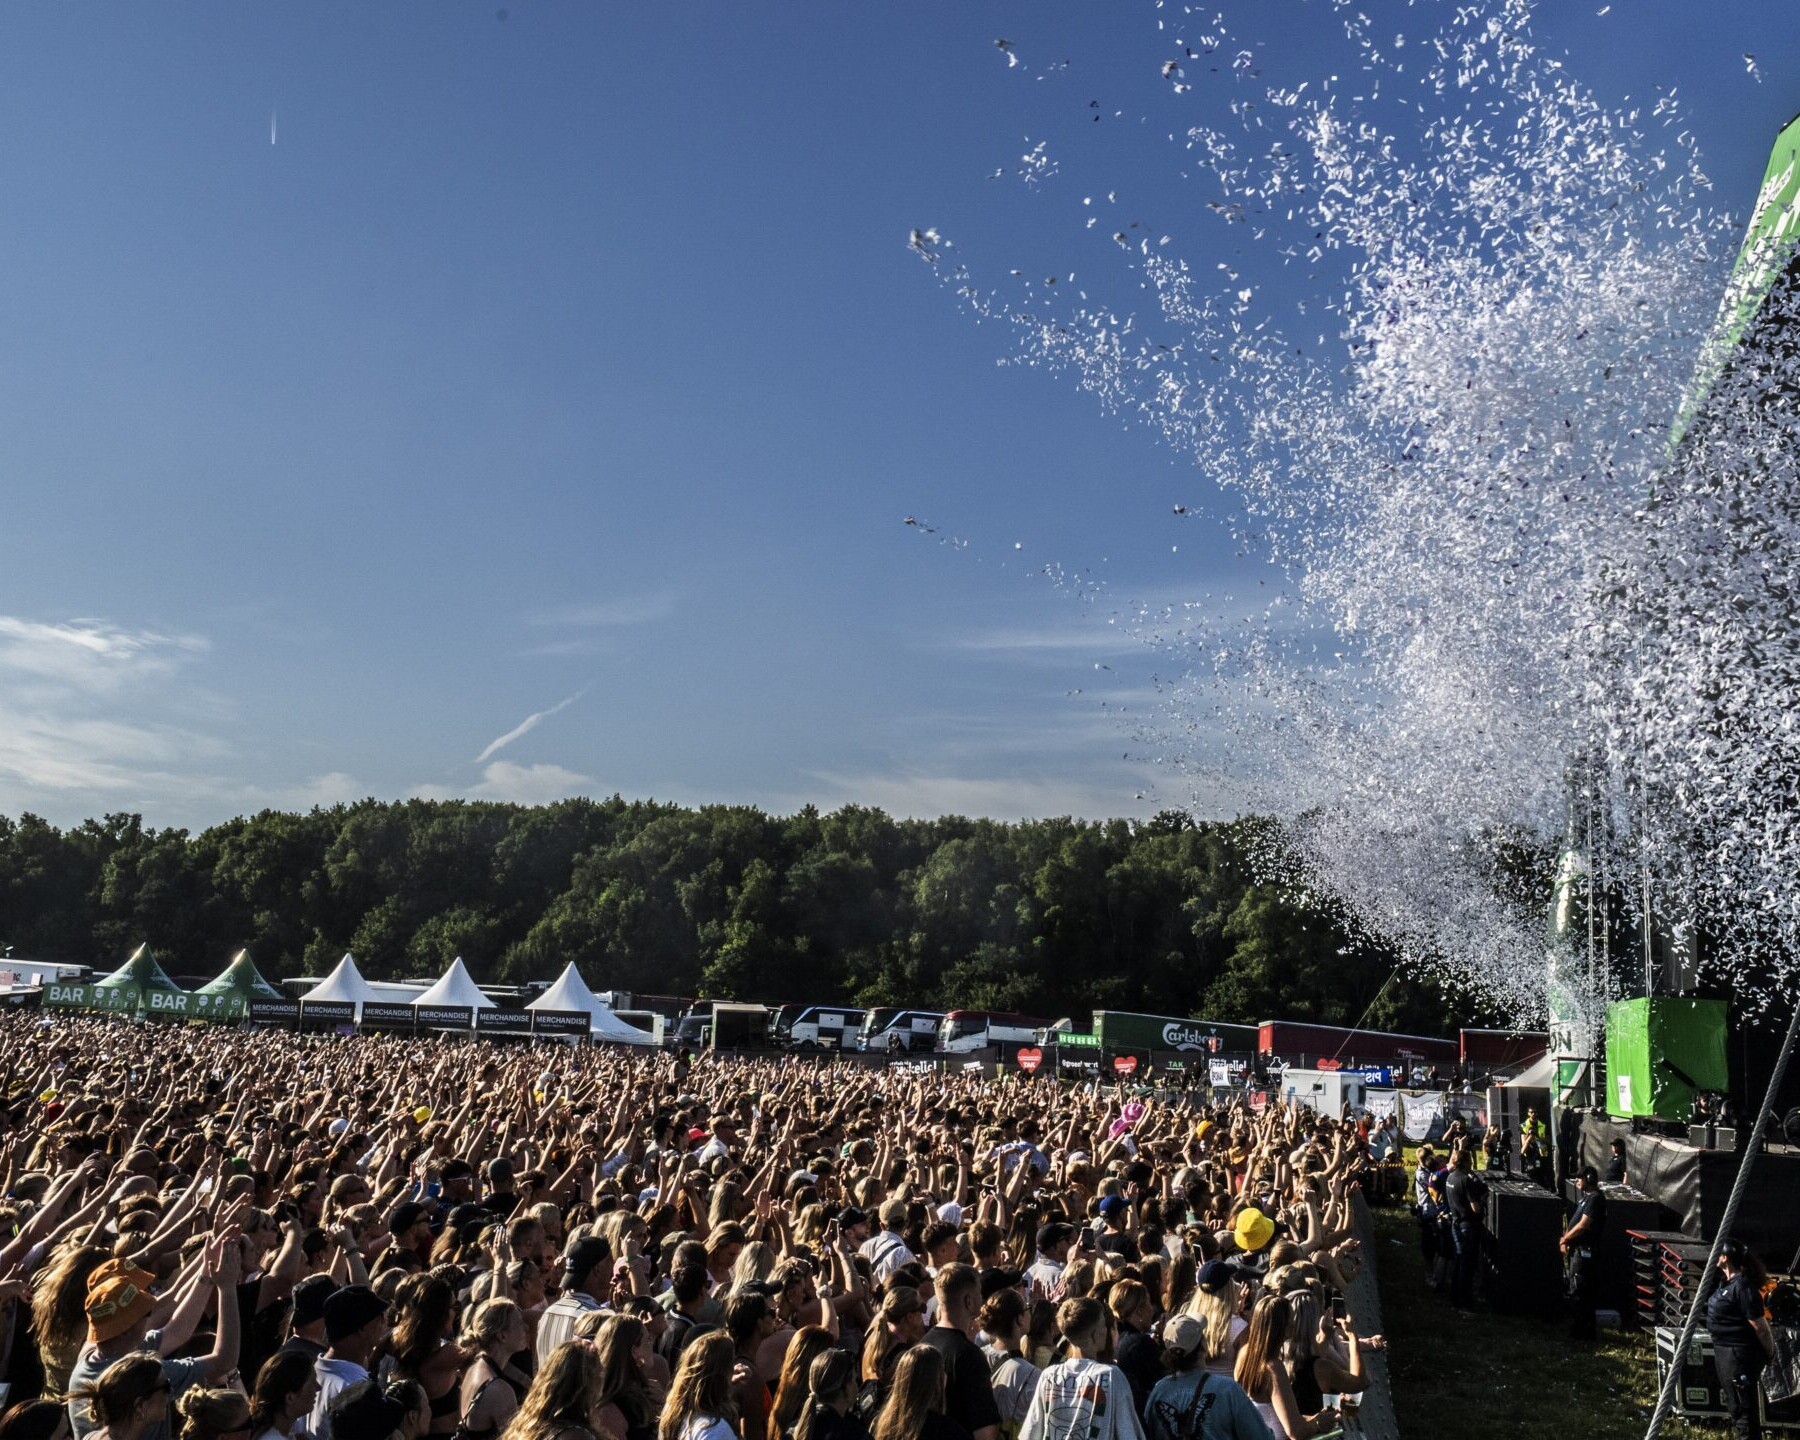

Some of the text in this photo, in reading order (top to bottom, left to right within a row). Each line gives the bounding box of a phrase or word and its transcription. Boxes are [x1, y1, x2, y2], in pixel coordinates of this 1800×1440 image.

[49, 986, 84, 1003] BAR
[151, 993, 187, 1010] BAR
[252, 1004, 299, 1013] MERCHANDISE
[304, 1005, 352, 1016] MERCHANDISE
[364, 1008, 413, 1018] MERCHANDISE
[419, 1010, 469, 1020] MERCHANDISE
[479, 1013, 530, 1023] MERCHANDISE
[536, 1015, 587, 1026] MERCHANDISE
[1022, 1061, 1036, 1069] TAK
